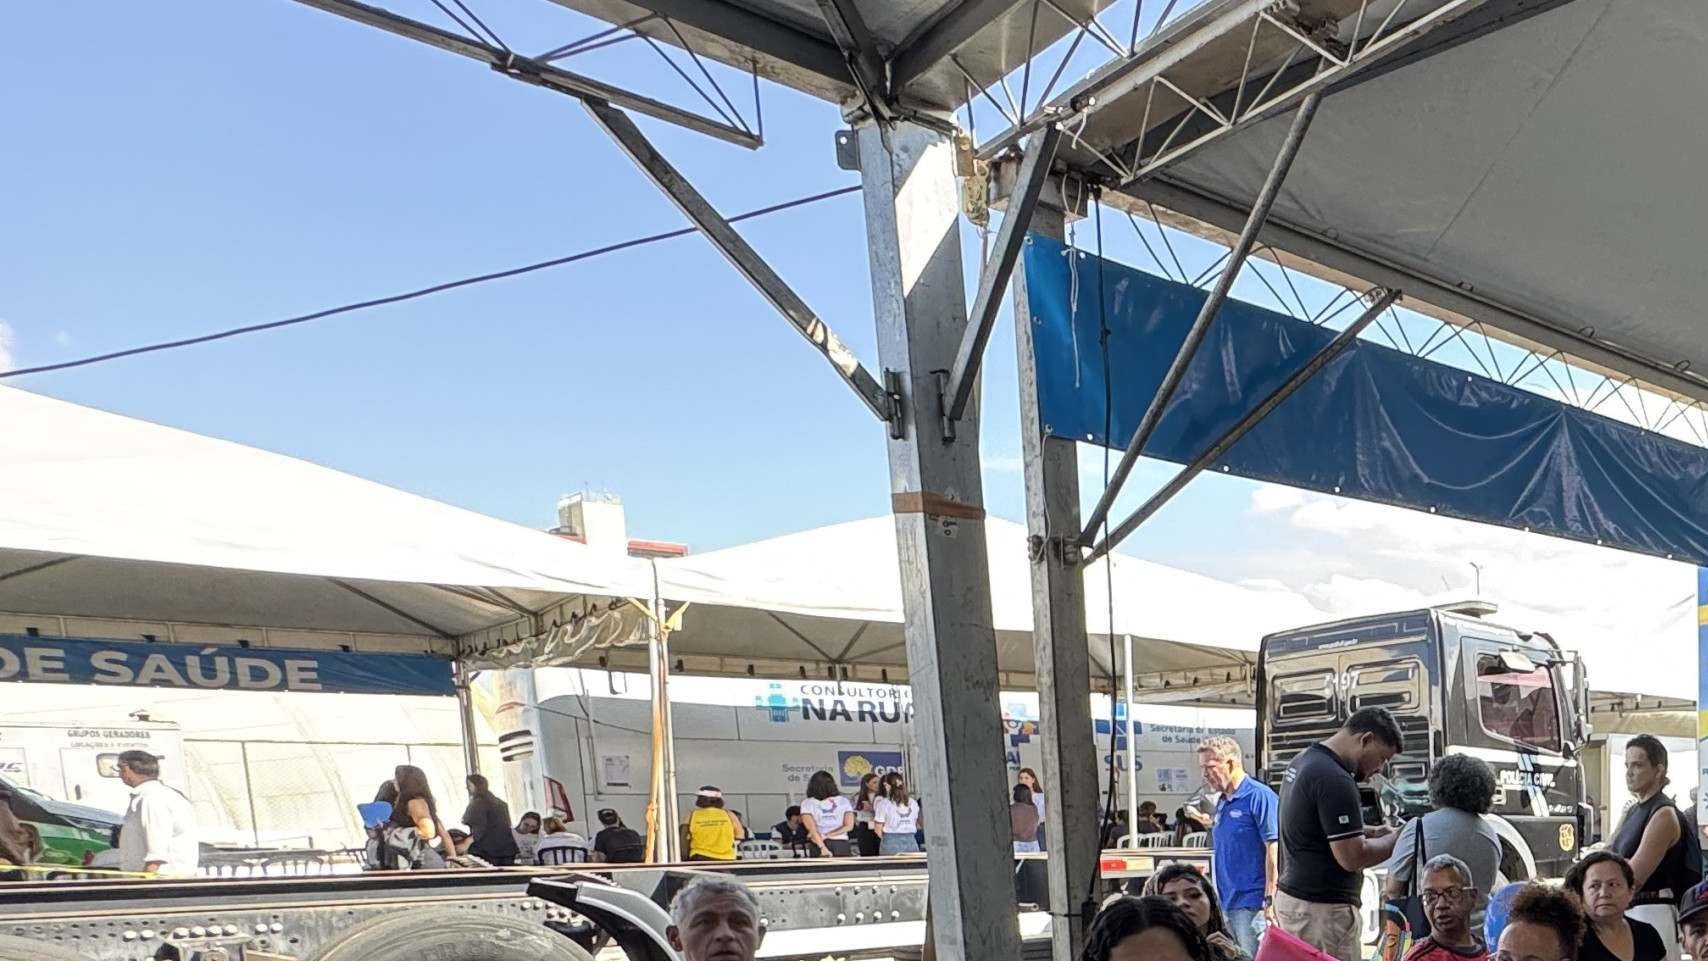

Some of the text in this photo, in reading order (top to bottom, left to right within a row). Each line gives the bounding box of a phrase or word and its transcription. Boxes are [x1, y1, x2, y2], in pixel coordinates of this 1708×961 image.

[89, 647, 323, 691] SAÚDE
[802, 698, 853, 722] NA
[67, 730, 151, 739] GRUPOS GERADORES
